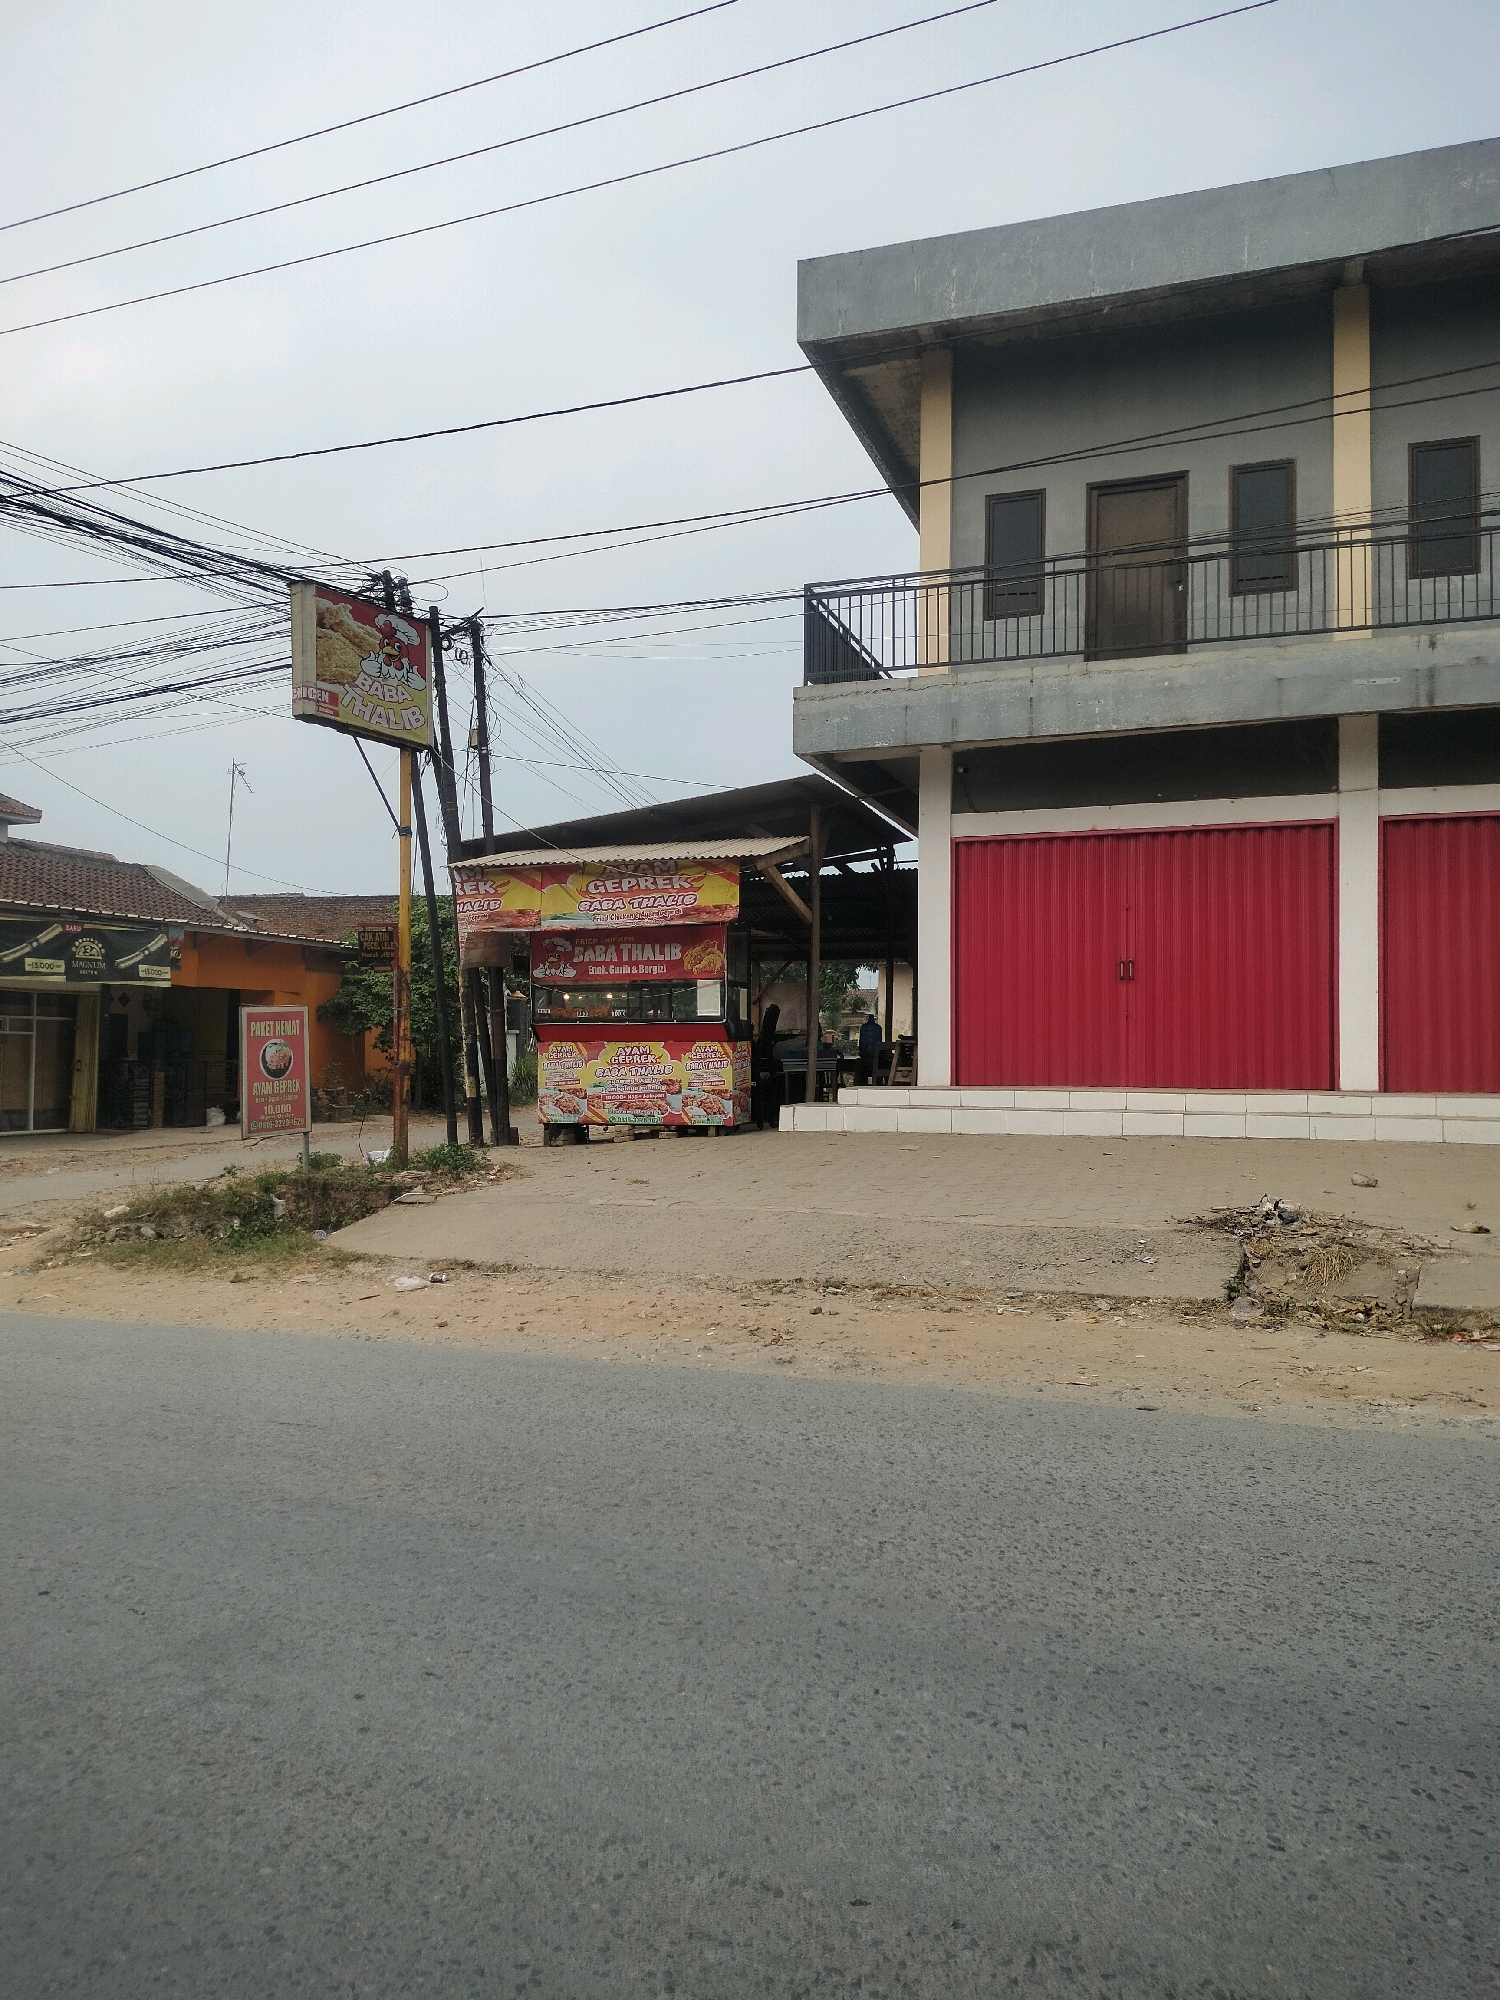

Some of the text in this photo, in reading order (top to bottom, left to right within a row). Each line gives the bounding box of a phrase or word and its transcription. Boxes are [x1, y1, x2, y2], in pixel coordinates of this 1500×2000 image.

[355, 672, 413, 704] BABA
[340, 684, 426, 730] THALIB
[601, 860, 678, 880] AYAM
[587, 875, 692, 894] GEPREK
[578, 893, 698, 912] BABA THALIB
[592, 914, 609, 922] Fried
[610, 913, 634, 921] Chicken
[65, 924, 82, 932] BARU
[360, 932, 374, 942] CAK
[78, 945, 98, 957] 234
[381, 942, 394, 950] LELE
[573, 943, 682, 963] BABA THALIB
[71, 961, 106, 970] MAGNUM
[631, 965, 638, 974] &
[638, 963, 667, 975] Bergizi
[250, 1019, 301, 1037] PAKET HEMAT
[617, 1046, 650, 1056] AYAM
[695, 1045, 718, 1053] AYAM
[610, 1054, 657, 1064] GEPREK
[595, 1065, 673, 1078] BABA THALIB
[253, 1079, 301, 1096] AYAM GEPREK
[263, 1104, 292, 1115] 10.000
